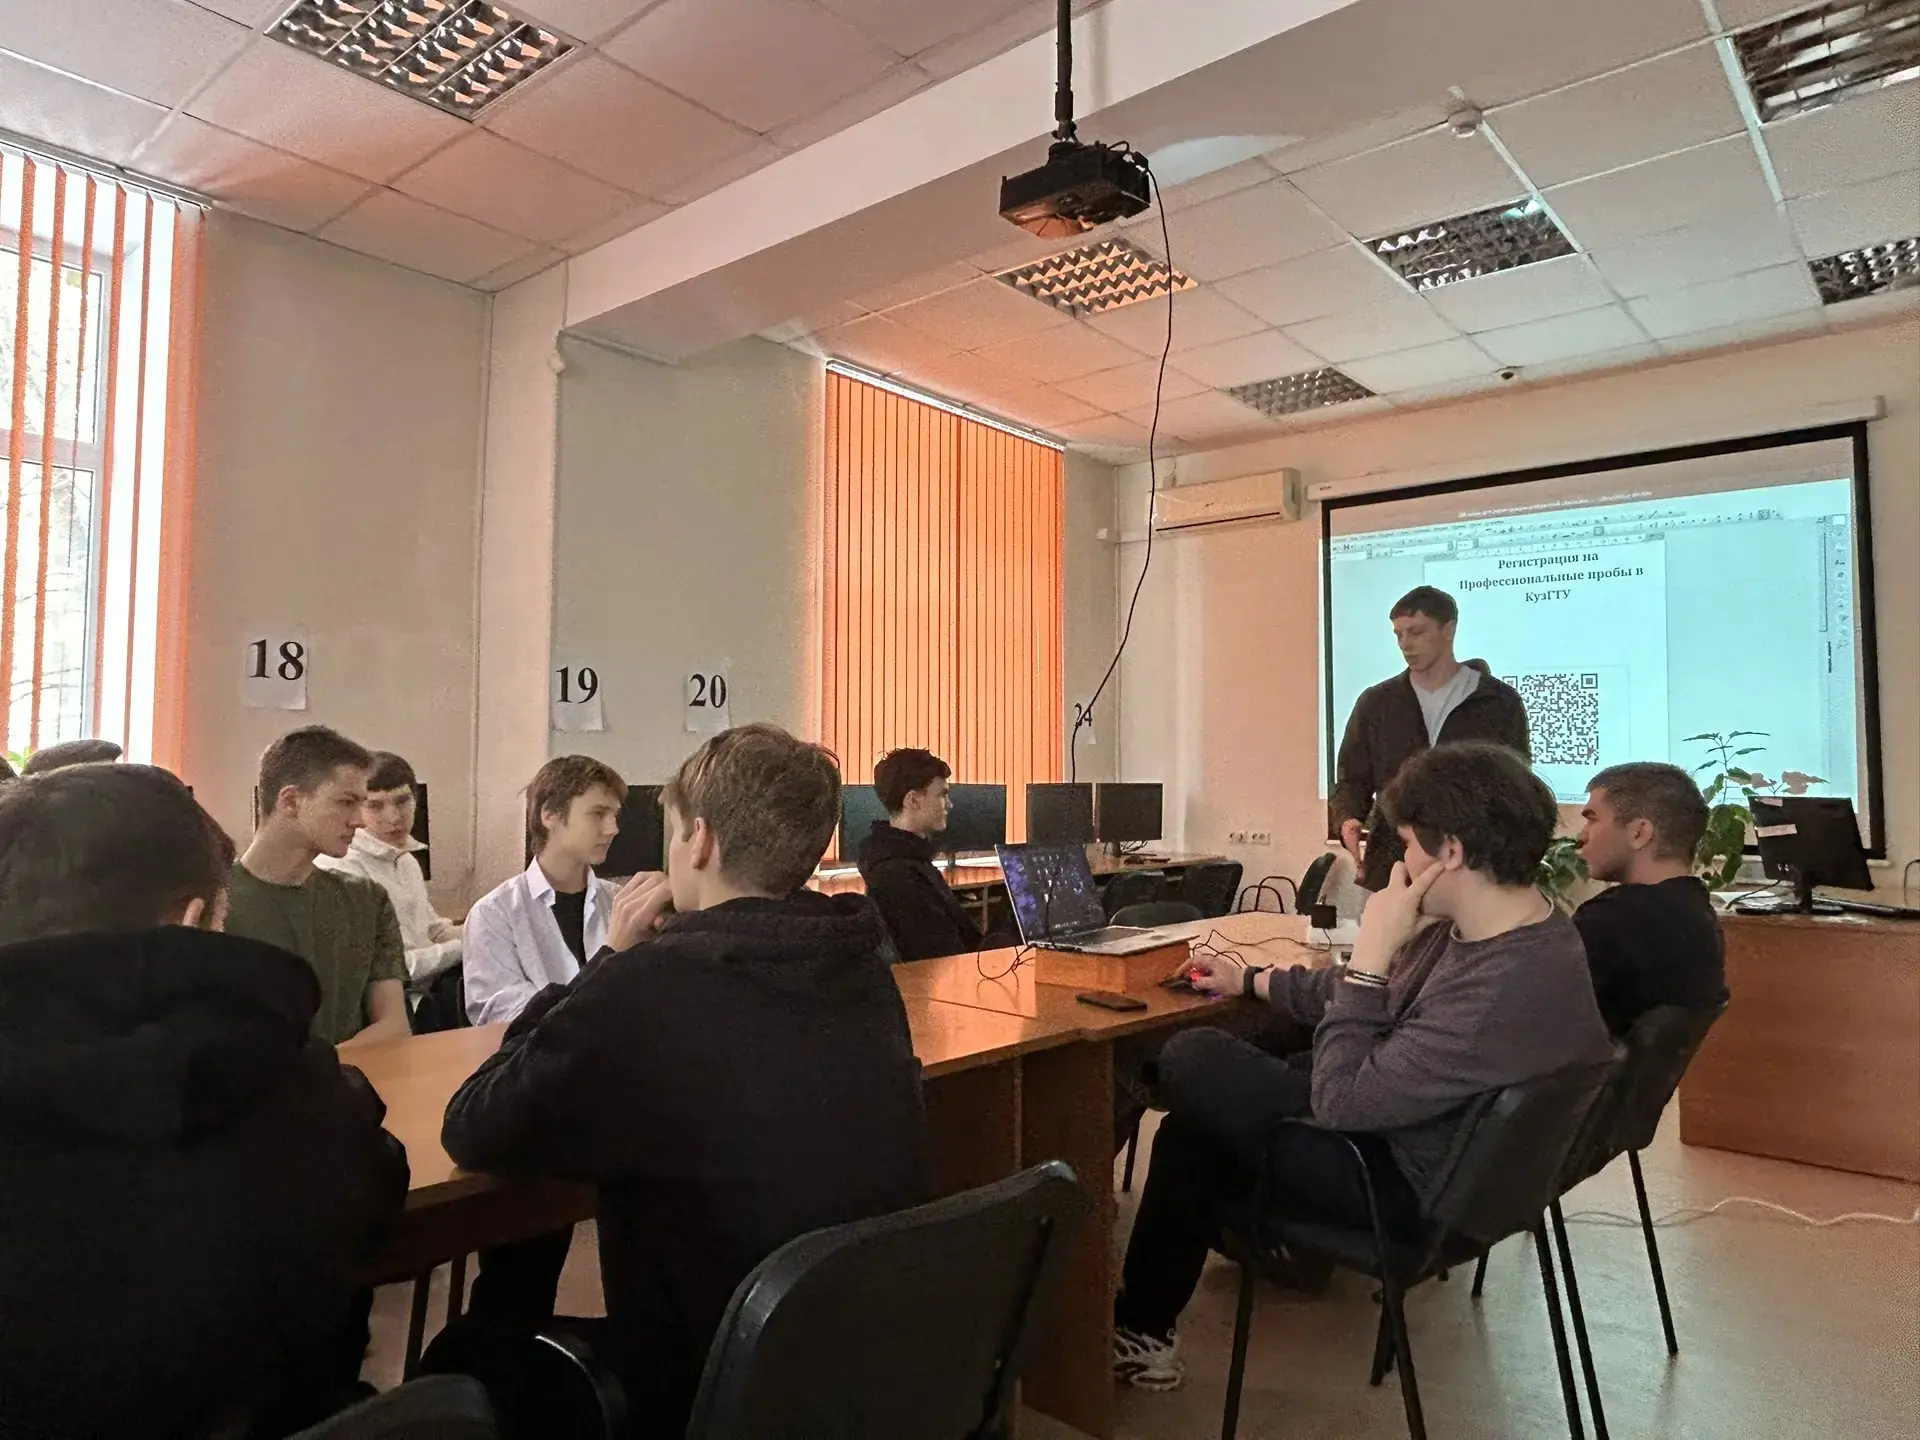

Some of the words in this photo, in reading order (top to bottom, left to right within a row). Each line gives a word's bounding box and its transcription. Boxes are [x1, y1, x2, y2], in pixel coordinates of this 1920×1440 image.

[1498, 554, 1579, 569] Регистрация
[1583, 553, 1599, 562] на
[1459, 572, 1584, 591] Профессиональные
[1588, 567, 1632, 581] пробы
[1635, 567, 1644, 576] в
[1525, 588, 1571, 603] КузГТУ
[248, 639, 304, 681] 18
[555, 666, 599, 704] 19
[688, 673, 727, 708] 20
